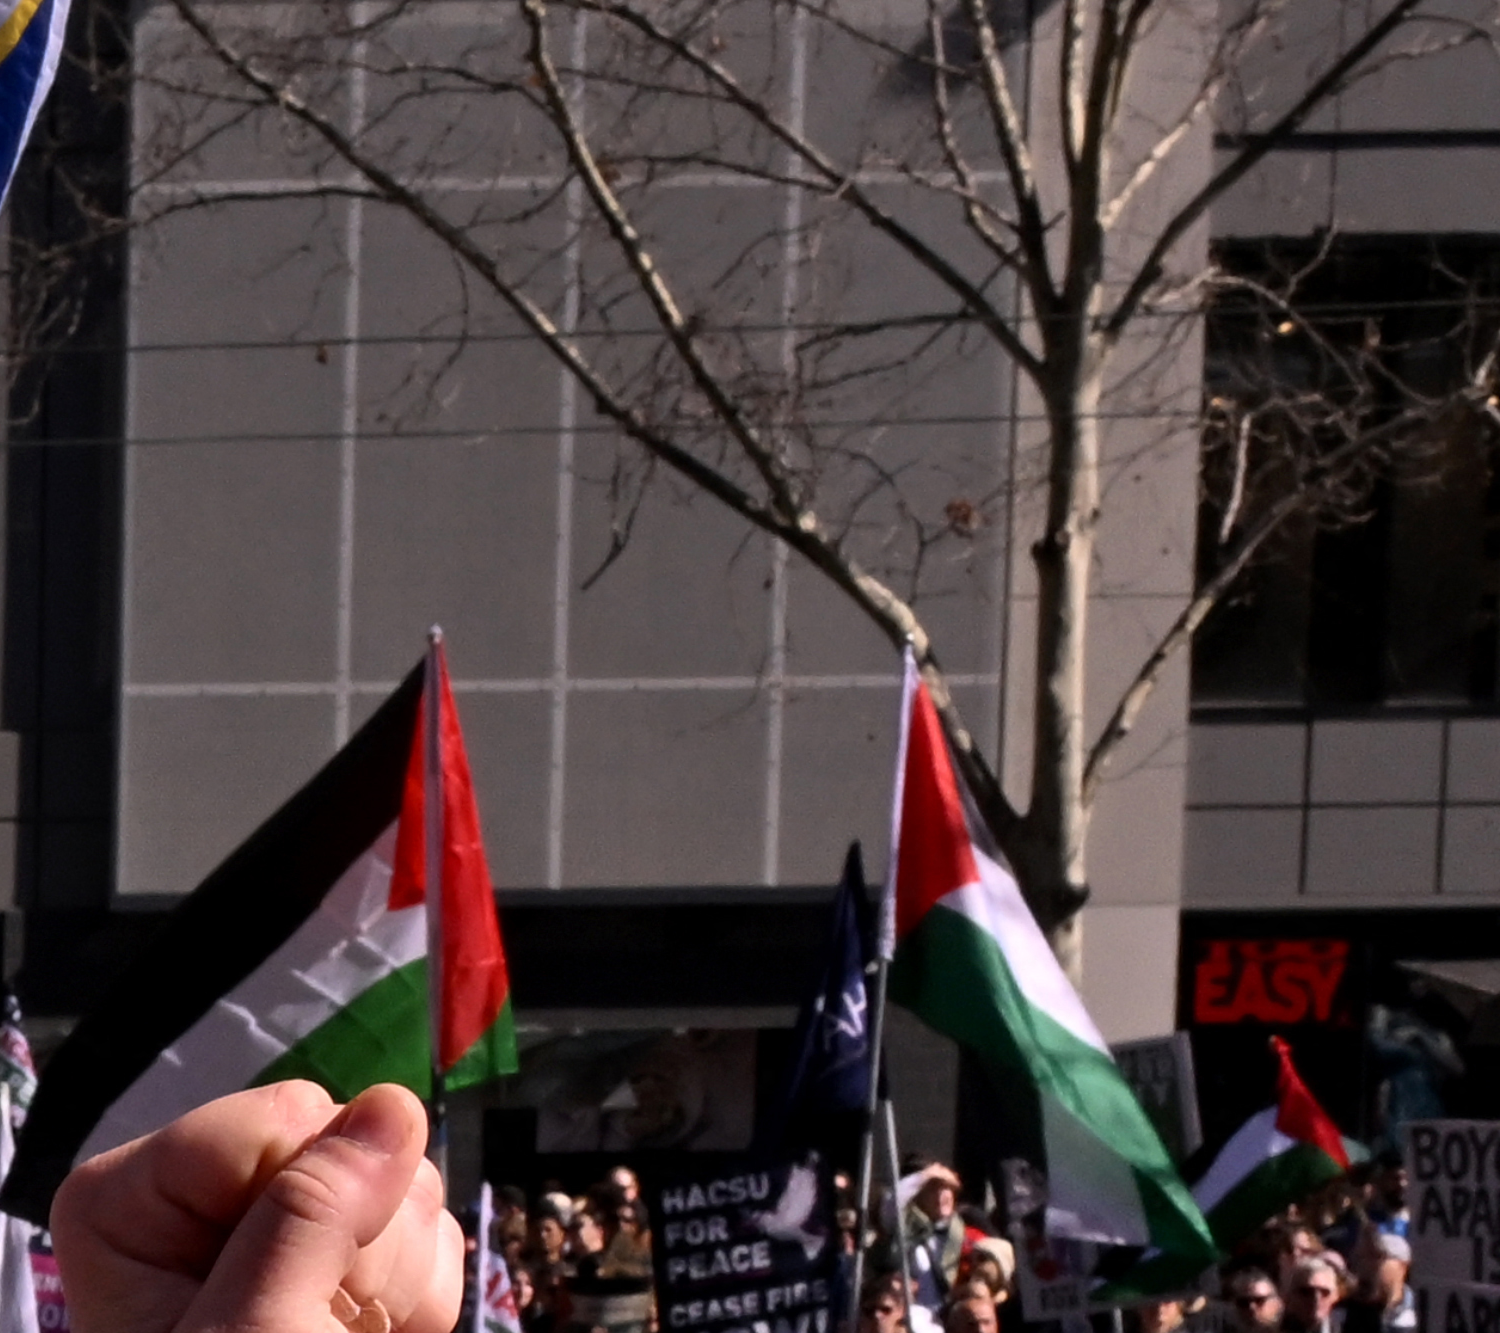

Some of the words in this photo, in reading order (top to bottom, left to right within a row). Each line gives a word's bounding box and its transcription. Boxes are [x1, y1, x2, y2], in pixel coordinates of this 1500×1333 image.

[1195, 962, 1346, 1023] EASY
[1412, 1126, 1500, 1182] BOY
[662, 1174, 770, 1213] HACSU
[1419, 1184, 1500, 1237] APA
[665, 1216, 729, 1248] FOR
[668, 1241, 771, 1283] PEACE
[669, 1292, 758, 1327] CEASE
[767, 1280, 829, 1313] FIRE
